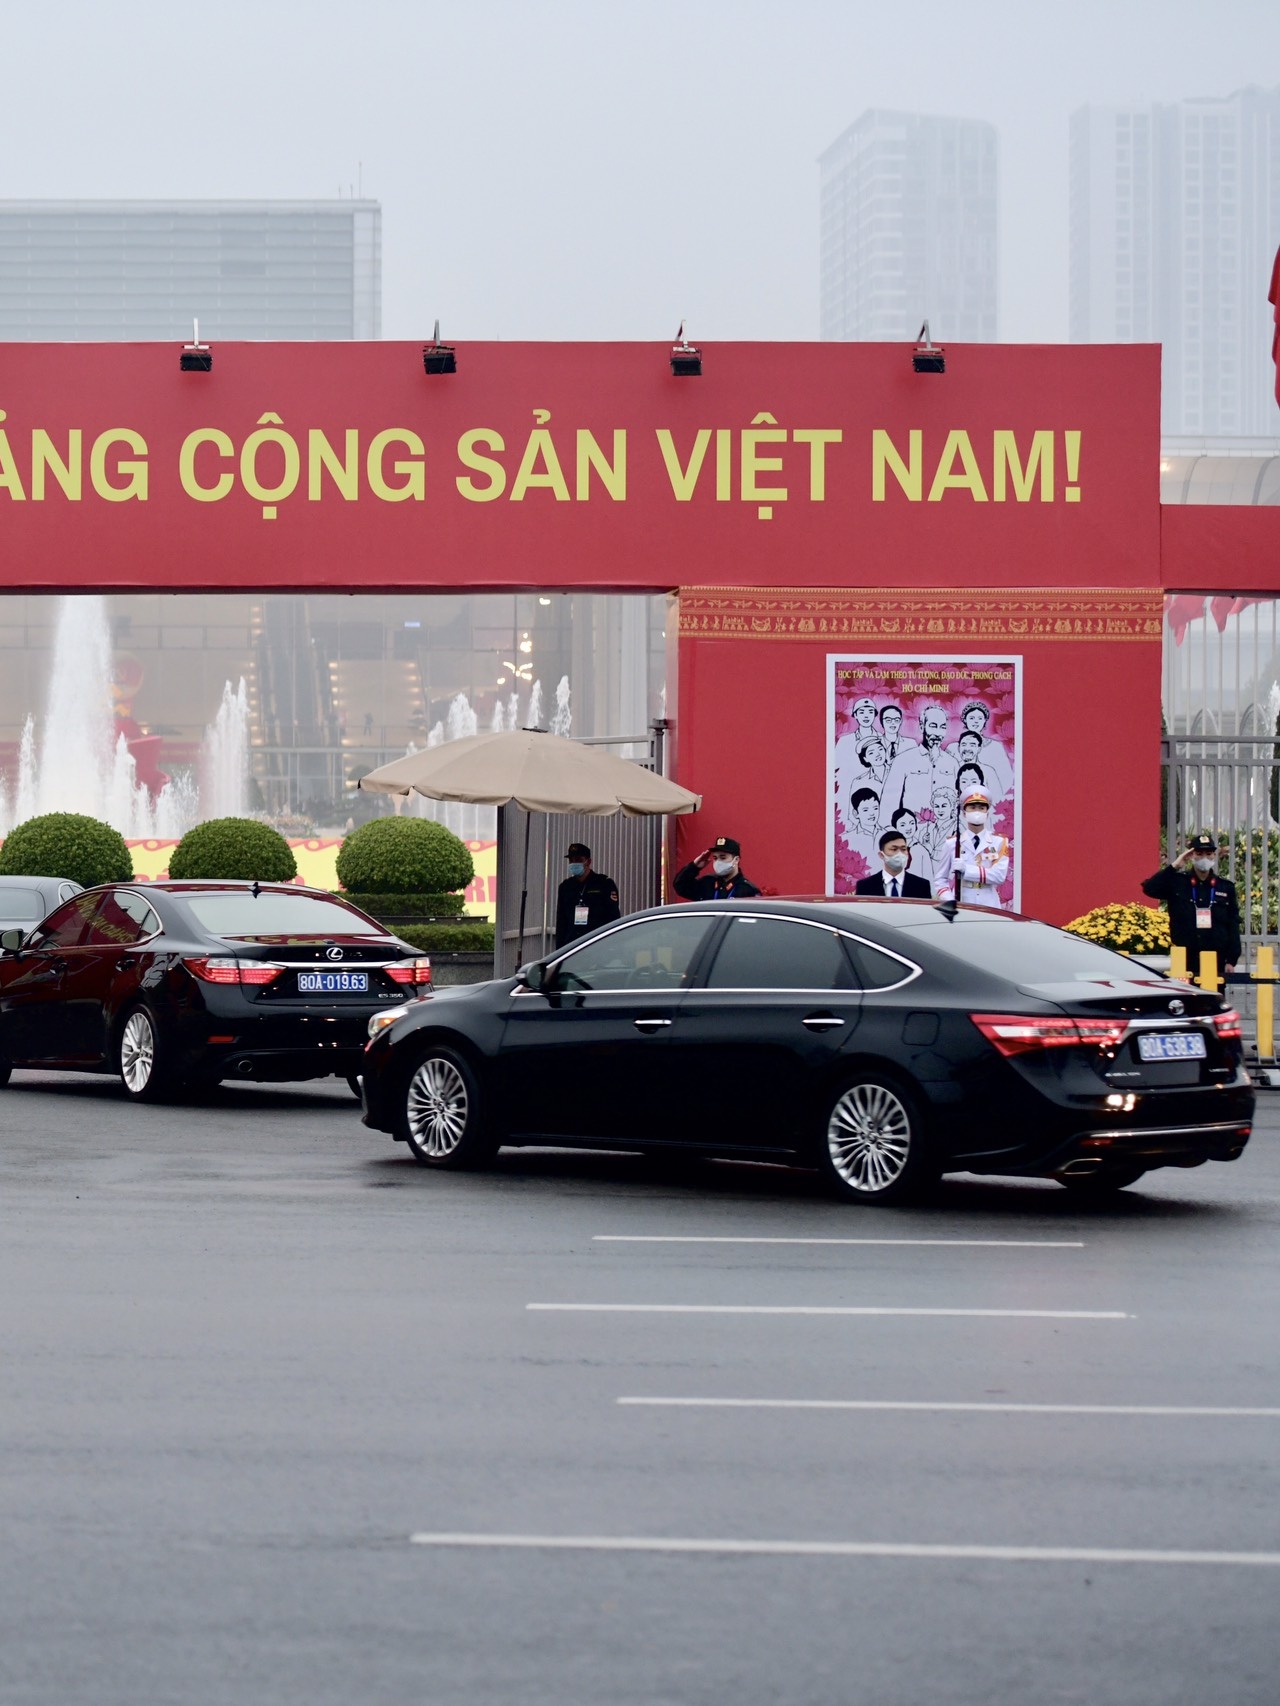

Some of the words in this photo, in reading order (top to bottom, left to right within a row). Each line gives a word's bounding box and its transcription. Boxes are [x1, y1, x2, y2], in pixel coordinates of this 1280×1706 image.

[180, 412, 425, 520] CỘNG
[456, 409, 626, 503] SẢN
[656, 412, 842, 520] VIỆT
[873, 430, 1081, 503] NAM!
[891, 671, 907, 679] THEO
[972, 671, 993, 680] PHONG
[902, 681, 913, 693] HỒ
[914, 681, 928, 693] CHÍ
[929, 683, 949, 693] MINH
[300, 975, 366, 990] 80A-019.63
